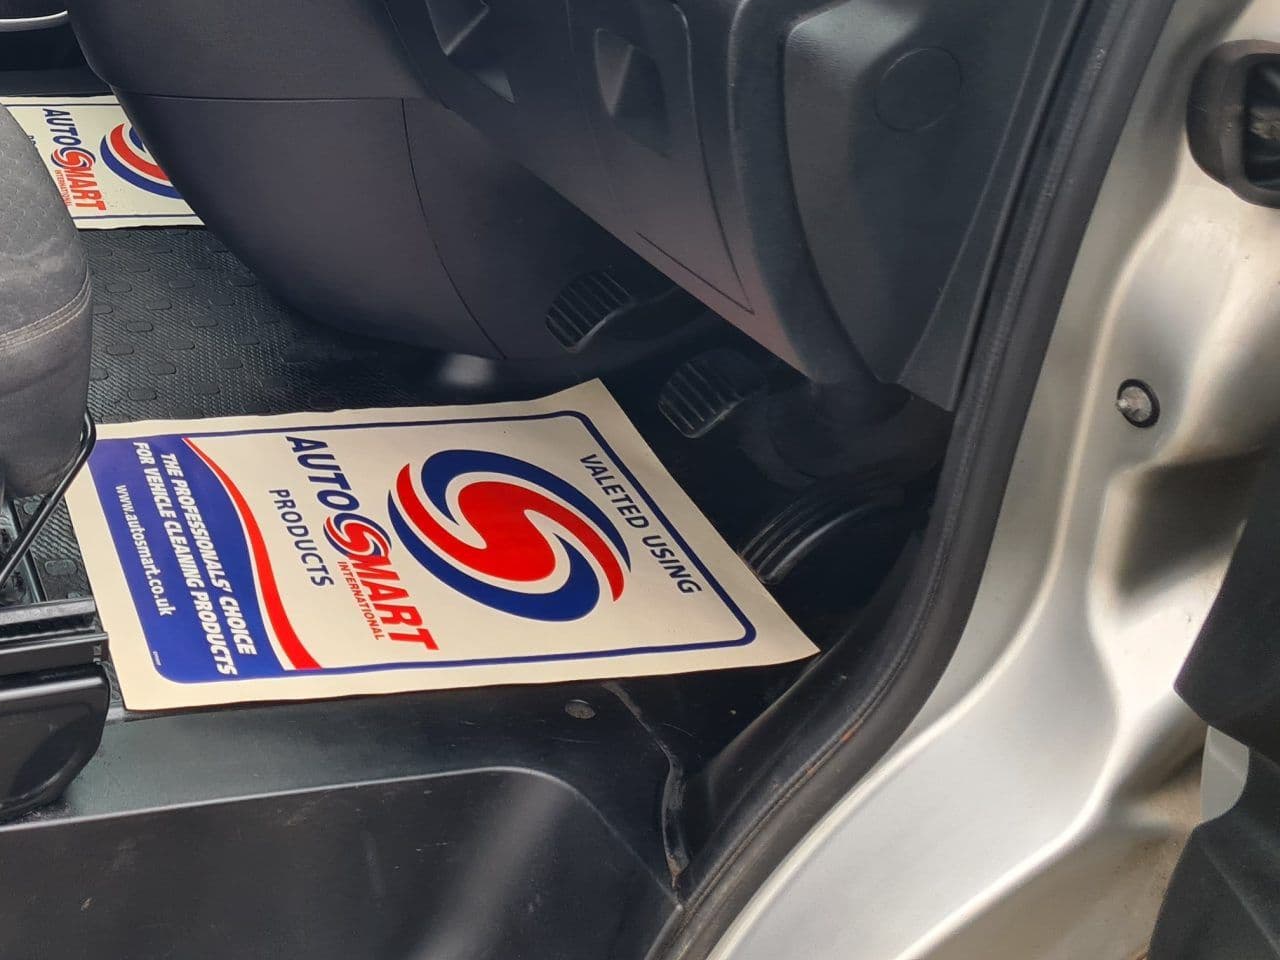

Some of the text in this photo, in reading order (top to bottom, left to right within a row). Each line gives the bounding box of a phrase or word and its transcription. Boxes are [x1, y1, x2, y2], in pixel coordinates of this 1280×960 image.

[115, 484, 177, 617] www.autosmart.co.uk
[133, 441, 238, 676] FOR VEHICLE CLEANING PRODUCTS
[161, 452, 258, 656] THE PROFESSIONALS' CHOICE
[269, 488, 335, 587] PRODUCTS
[285, 435, 440, 651] AUTOSMART
[579, 454, 703, 594] VALETED USING
[337, 561, 386, 641] INTERNATIONAL
